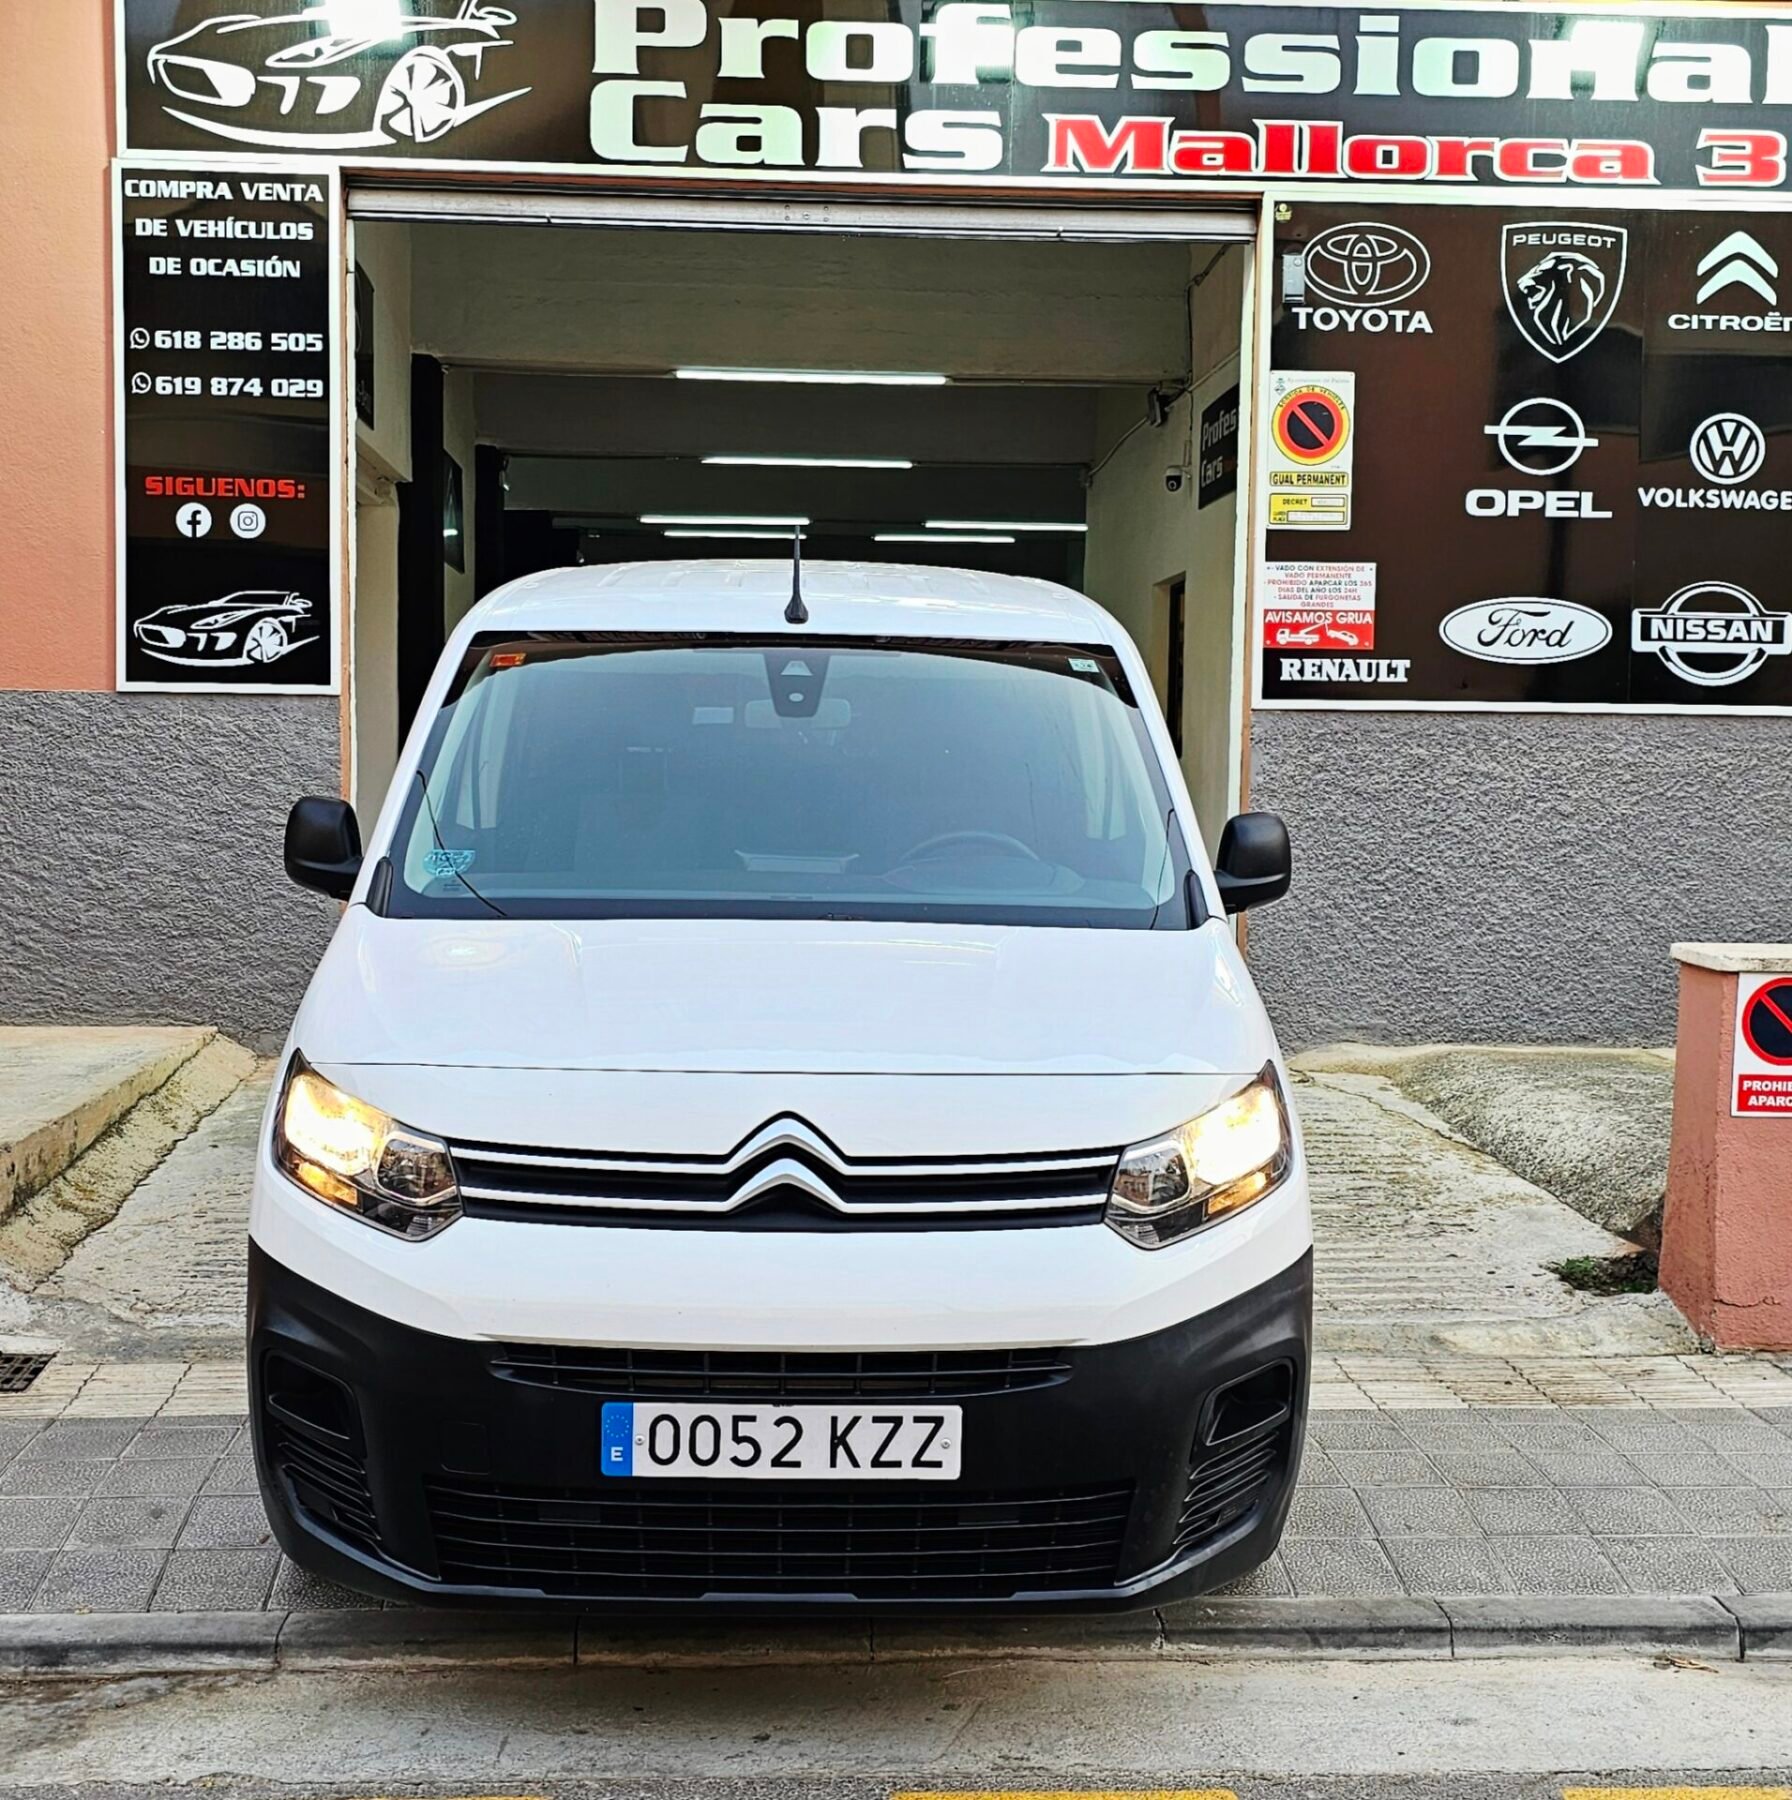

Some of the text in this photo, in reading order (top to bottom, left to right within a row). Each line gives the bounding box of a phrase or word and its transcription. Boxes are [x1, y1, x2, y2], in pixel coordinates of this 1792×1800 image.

[592, 0, 1792, 104] Professional
[590, 79, 1788, 187] Cars Mallorca 3
[124, 179, 324, 202] COMPRA VENTA
[135, 216, 314, 240] DE VEHÍCULOS
[1512, 233, 1616, 249] PEUGEOT
[149, 255, 300, 278] DE OCASIÓN
[1291, 307, 1434, 334] TOYOTA
[154, 330, 323, 351] 618 286 505
[155, 376, 324, 398] 619 874 029
[1201, 455, 1223, 488] Cars
[1272, 473, 1346, 485] GUAL PERMANENT
[145, 476, 305, 498] SIGUENOS:
[1465, 489, 1613, 518] OPEL
[1265, 611, 1373, 624] AVISAMOS GRUA
[1477, 607, 1575, 648] Ford
[1650, 618, 1773, 642] NISSAN
[1280, 658, 1411, 682] RENAULT
[610, 1413, 945, 1469] E 0052 KZZ
